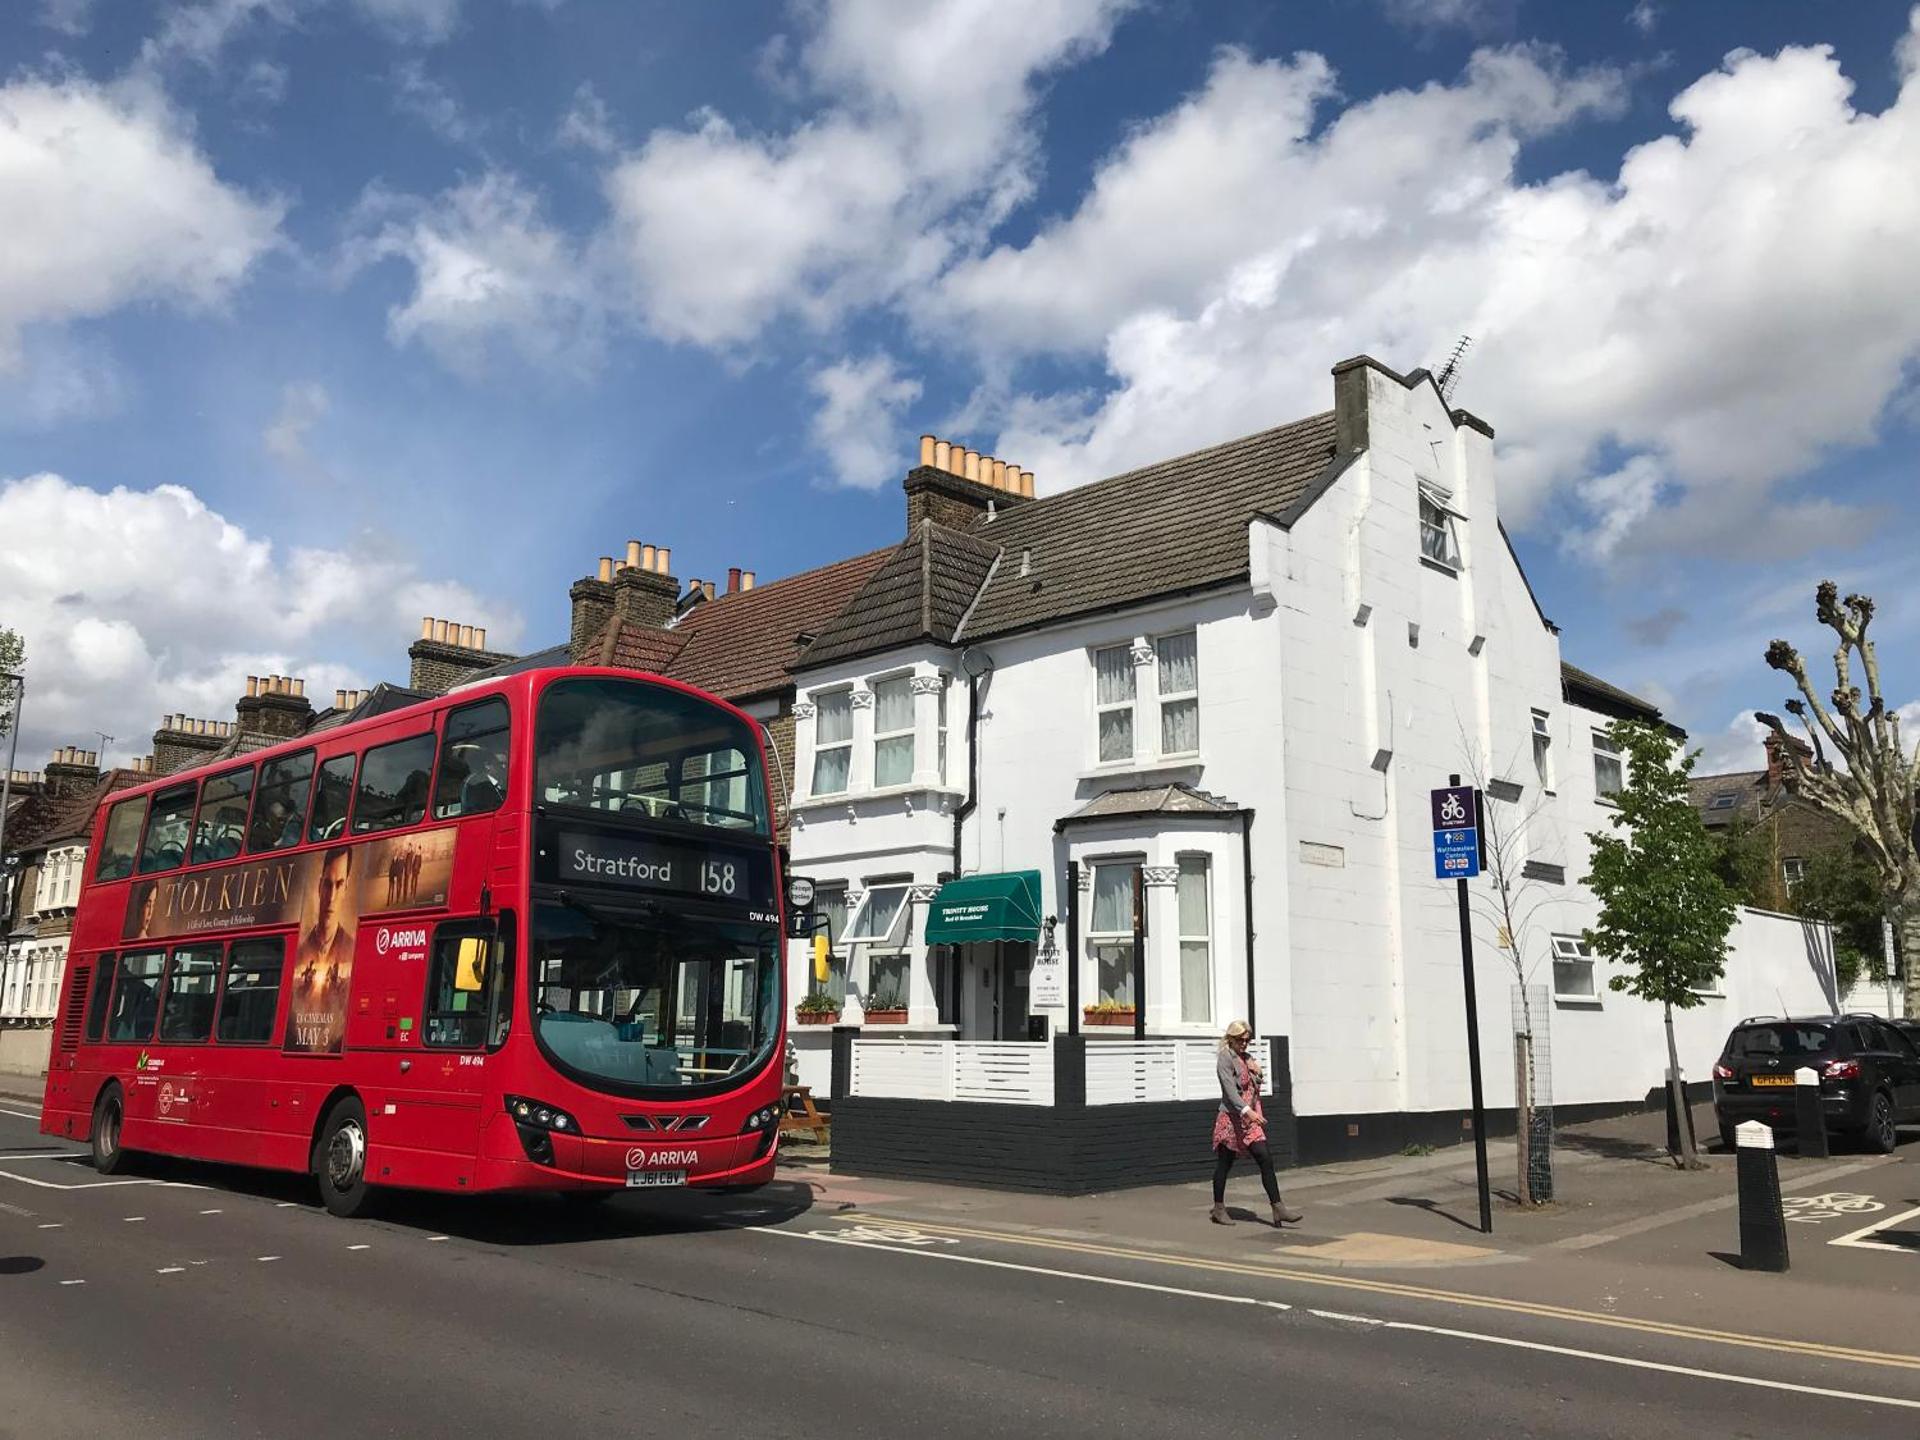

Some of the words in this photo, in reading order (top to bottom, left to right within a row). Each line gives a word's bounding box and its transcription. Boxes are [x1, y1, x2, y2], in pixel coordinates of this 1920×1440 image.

[573, 849, 671, 881] Stratford
[701, 860, 736, 895] 158
[164, 863, 295, 918] TOLKIEN
[749, 912, 764, 922] DW
[764, 914, 780, 924] 494
[390, 929, 426, 948] ARRIVA
[296, 1027, 321, 1046] MAY
[321, 1028, 329, 1046] 3
[400, 1032, 409, 1042] EC
[460, 1055, 472, 1066] DW
[472, 1056, 484, 1067] 494
[647, 1150, 699, 1166] ARRIVA
